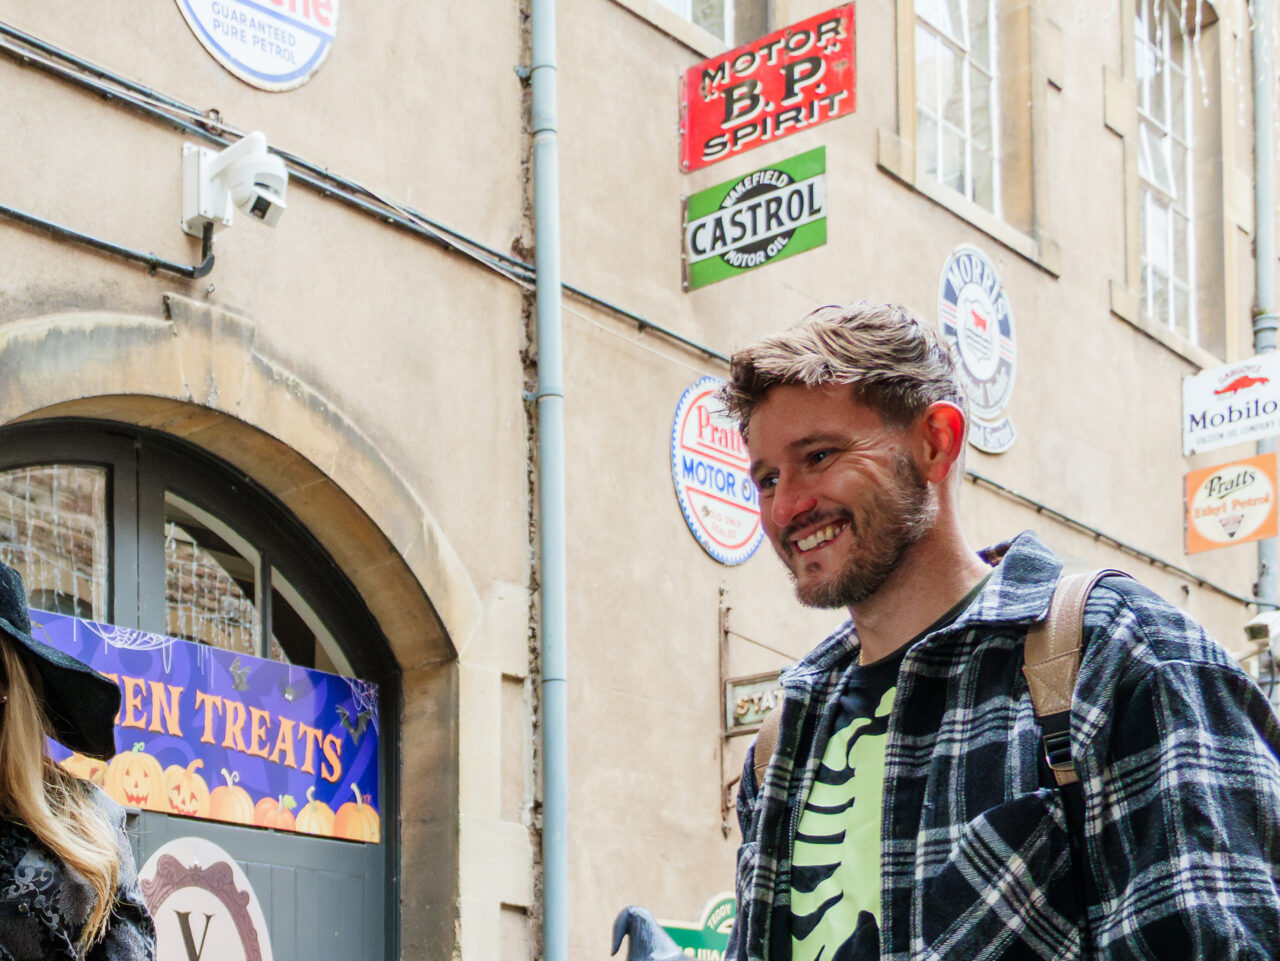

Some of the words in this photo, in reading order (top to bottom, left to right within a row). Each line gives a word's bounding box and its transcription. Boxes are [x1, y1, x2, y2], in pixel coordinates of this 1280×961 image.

[211, 2, 297, 47] GUARANTEED
[212, 19, 248, 43] PURE
[252, 35, 297, 65] PETROL
[702, 18, 846, 86] MOTOR
[702, 90, 848, 161] SPIRIT
[721, 170, 789, 207] WAKEFIELD
[690, 183, 822, 256] CASTROL
[724, 249, 767, 268] MOTOR
[767, 236, 789, 257] OIL
[948, 253, 1008, 320] MORRIS
[696, 404, 746, 456] Pratt
[1188, 398, 1280, 433] Mobilo
[682, 455, 736, 498] MOTOR
[741, 477, 758, 504] OI
[1205, 469, 1257, 499] Pratts
[736, 689, 784, 716] STAT
[195, 690, 342, 783] TREATS
[707, 904, 732, 929] TEDDY
